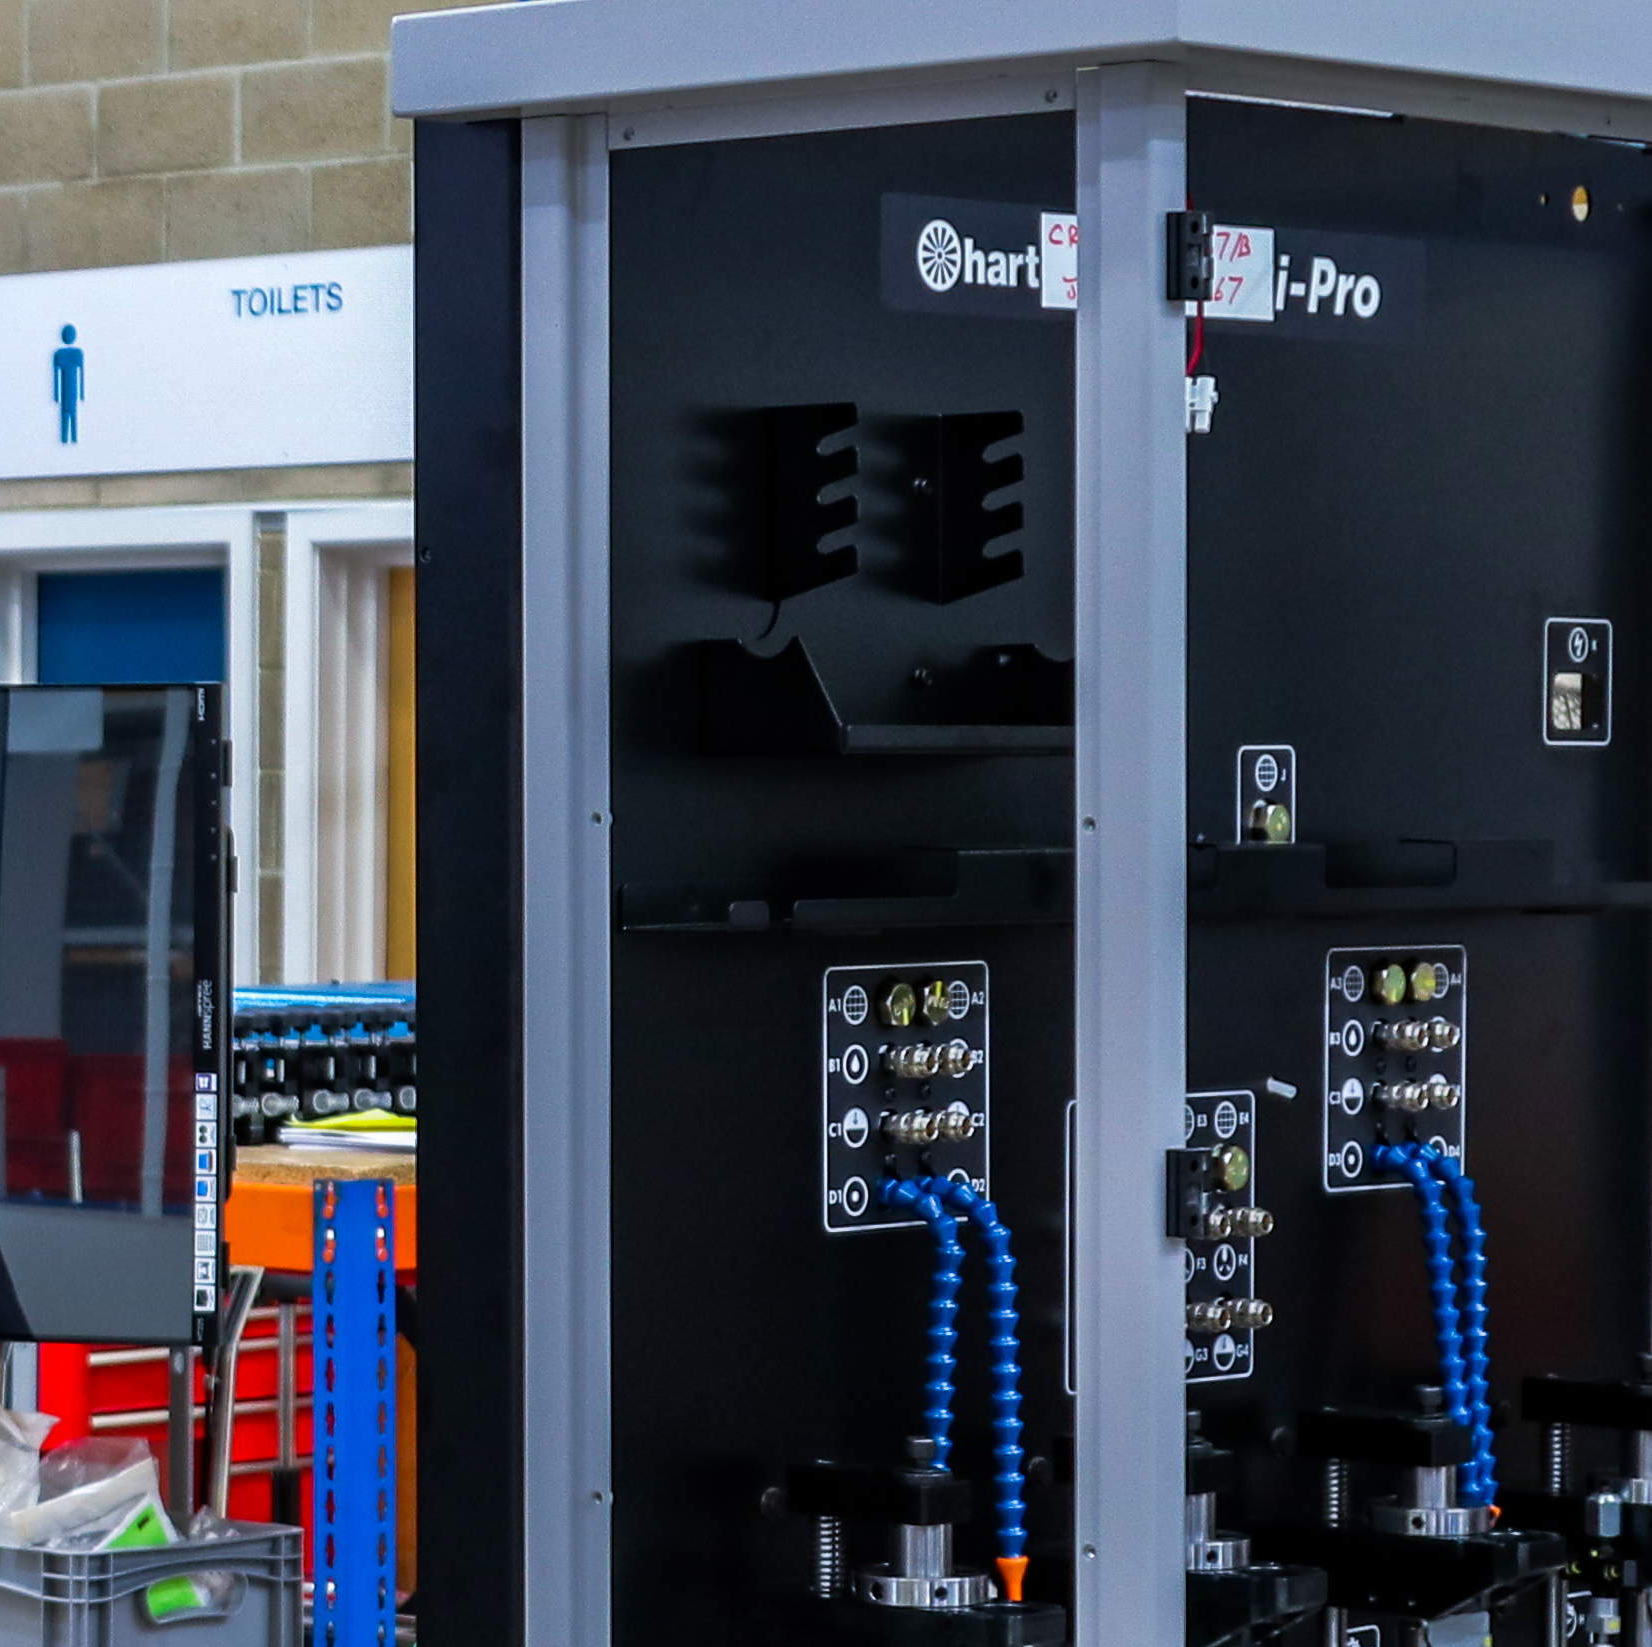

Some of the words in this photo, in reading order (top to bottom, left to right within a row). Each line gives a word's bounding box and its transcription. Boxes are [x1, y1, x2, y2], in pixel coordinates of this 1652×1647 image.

[1216, 232, 1253, 262] 7/B
[964, 237, 1040, 289] hart
[1277, 254, 1382, 320] i-Pro
[231, 281, 343, 318] TOILETS
[828, 997, 842, 1013] A1
[970, 991, 985, 1006] A2
[828, 1057, 841, 1073] B1
[828, 1122, 842, 1138] C1
[970, 1112, 986, 1128] C2
[1196, 1114, 1208, 1128] E3
[1328, 1152, 1342, 1167] D3
[828, 1189, 843, 1205] D1
[971, 1178, 986, 1193] D2
[1195, 1346, 1209, 1362] G3
